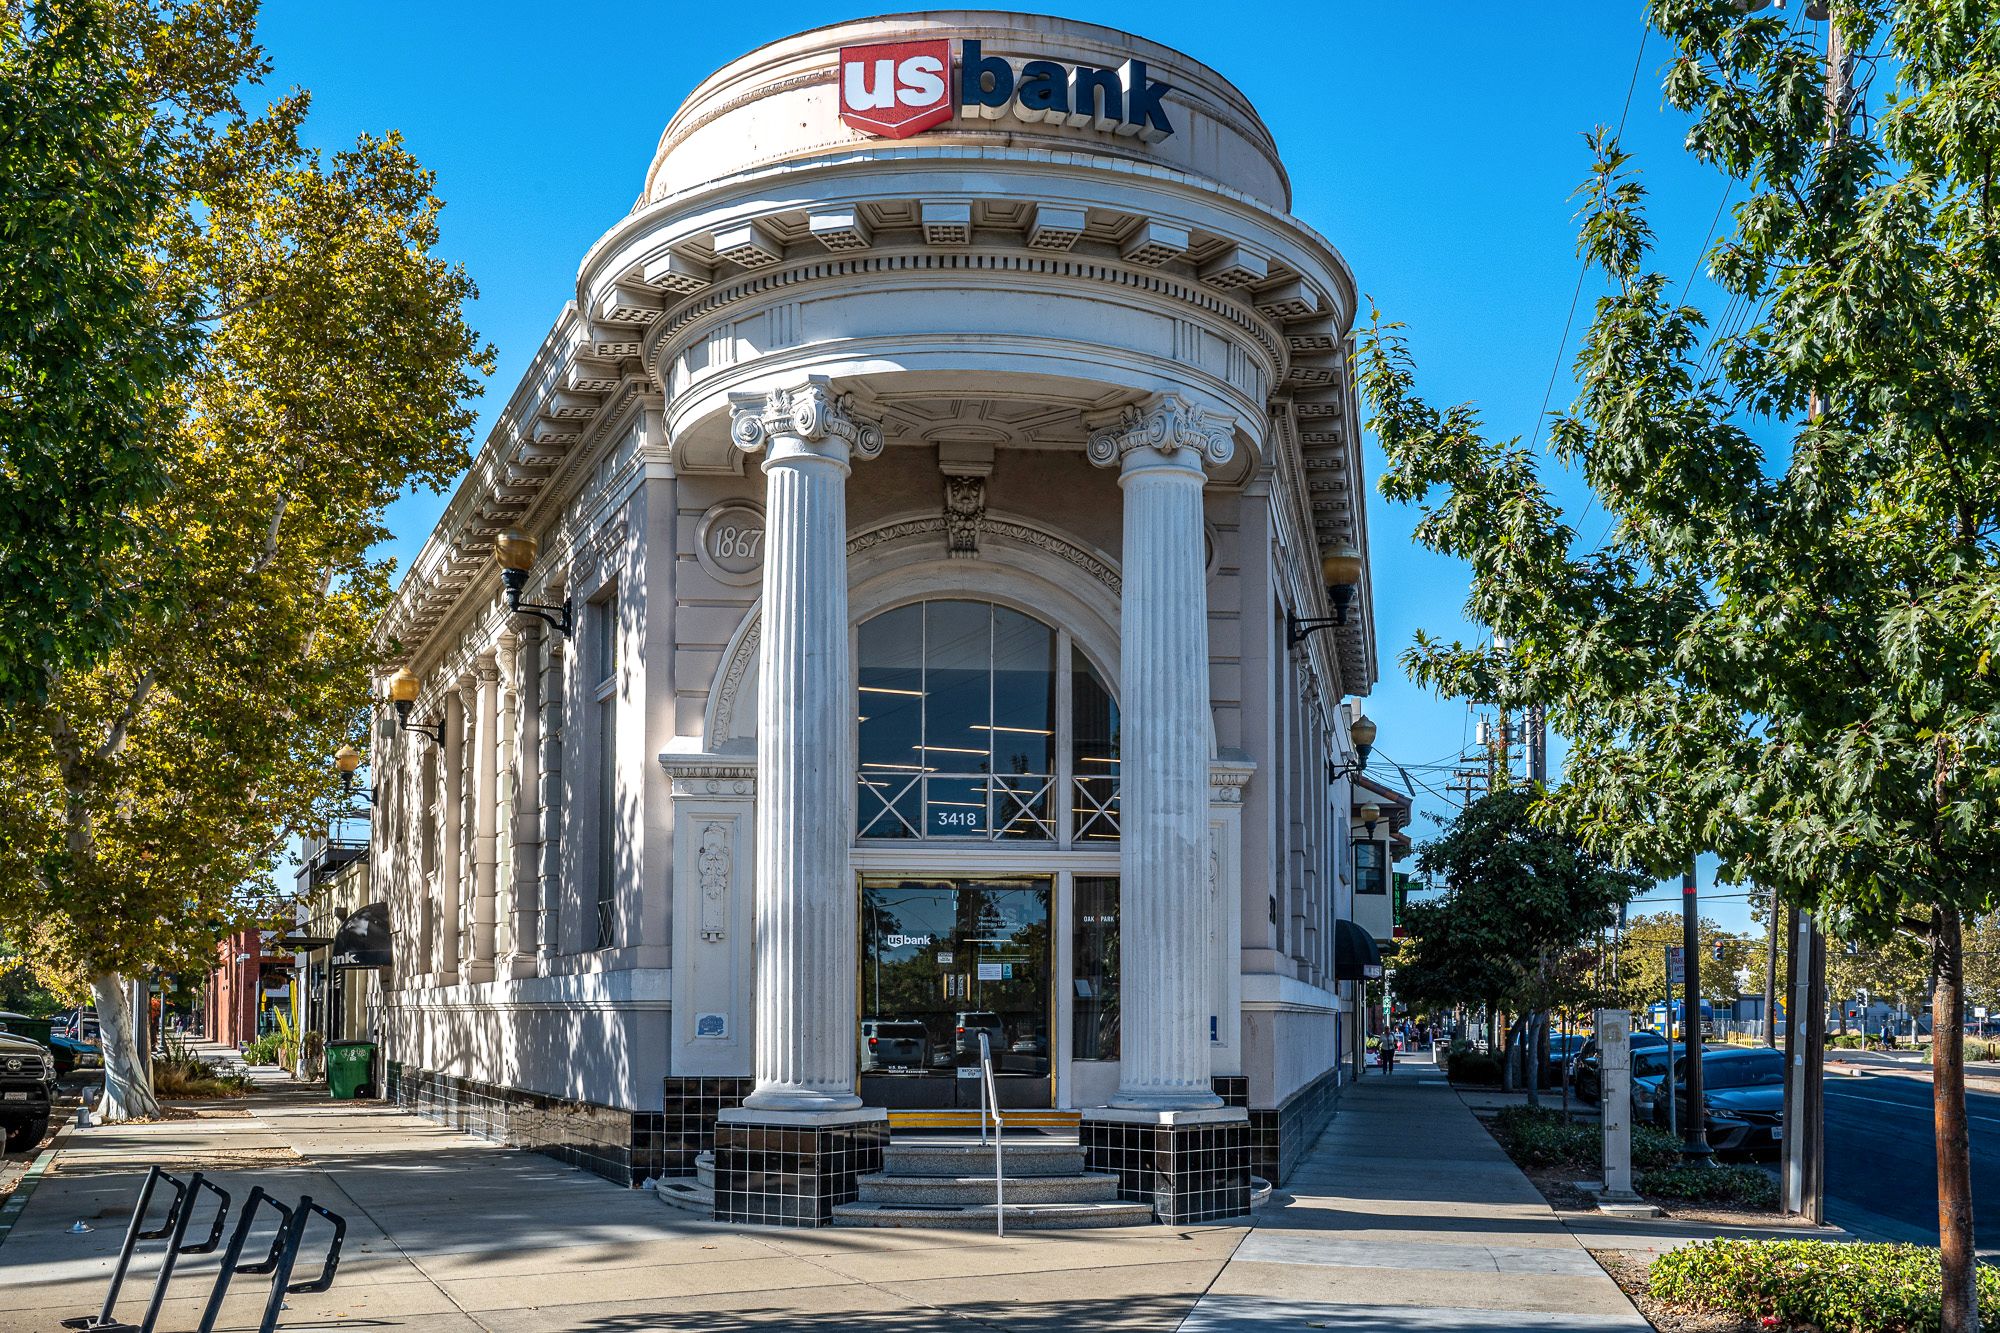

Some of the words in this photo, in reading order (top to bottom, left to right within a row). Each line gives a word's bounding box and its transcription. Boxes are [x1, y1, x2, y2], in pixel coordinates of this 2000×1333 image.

[961, 39, 1174, 138] bank
[715, 526, 765, 558] 1867
[938, 812, 976, 826] 3418
[903, 935, 931, 945] bank
